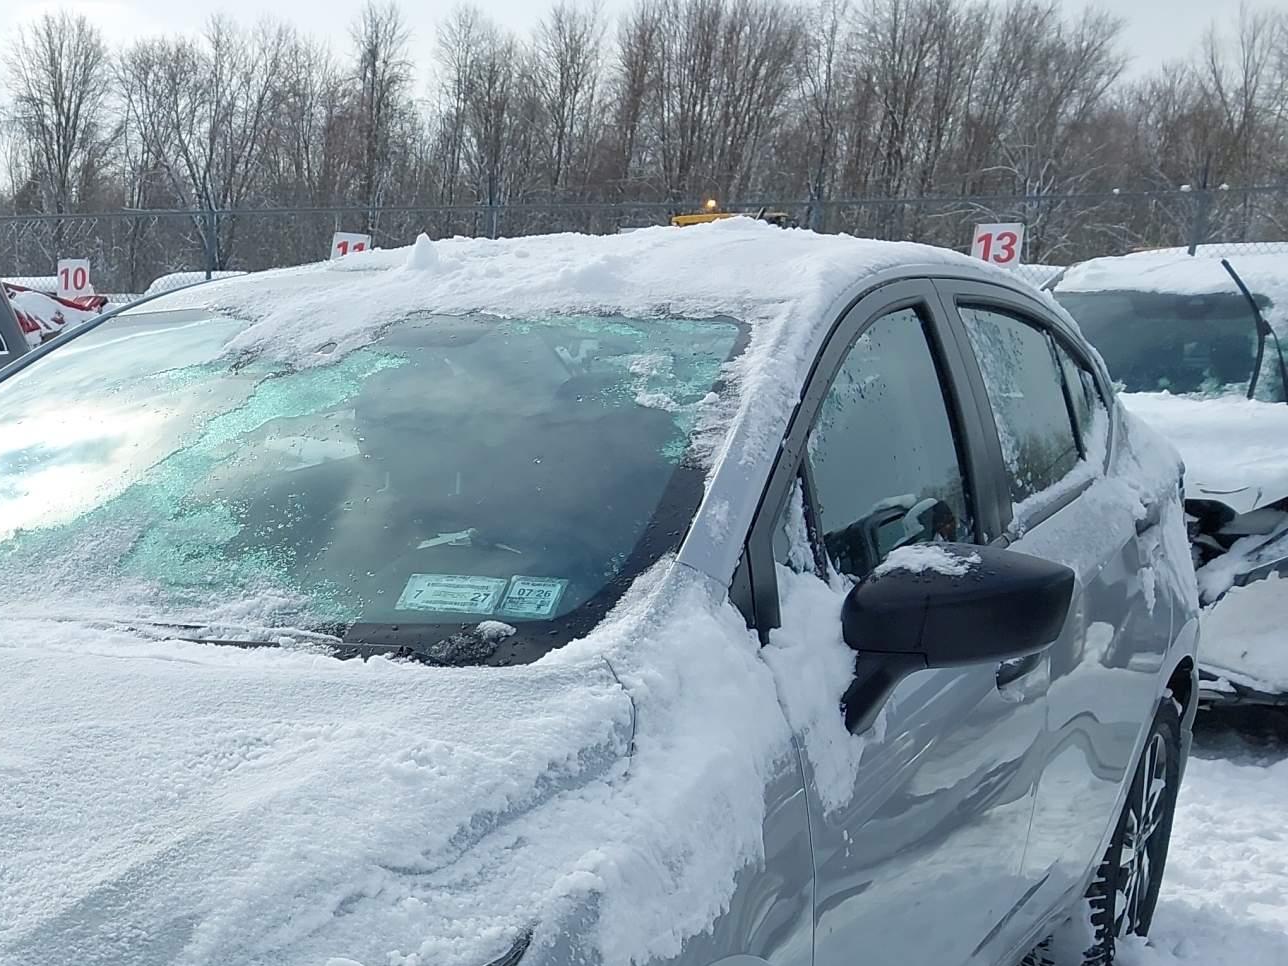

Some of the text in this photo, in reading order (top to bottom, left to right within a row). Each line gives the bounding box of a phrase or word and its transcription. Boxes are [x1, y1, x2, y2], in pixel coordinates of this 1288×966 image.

[977, 232, 1017, 263] 13
[60, 267, 86, 290] 10
[414, 589, 424, 599] 7
[470, 592, 490, 602] 27
[517, 588, 552, 598] 07 26
